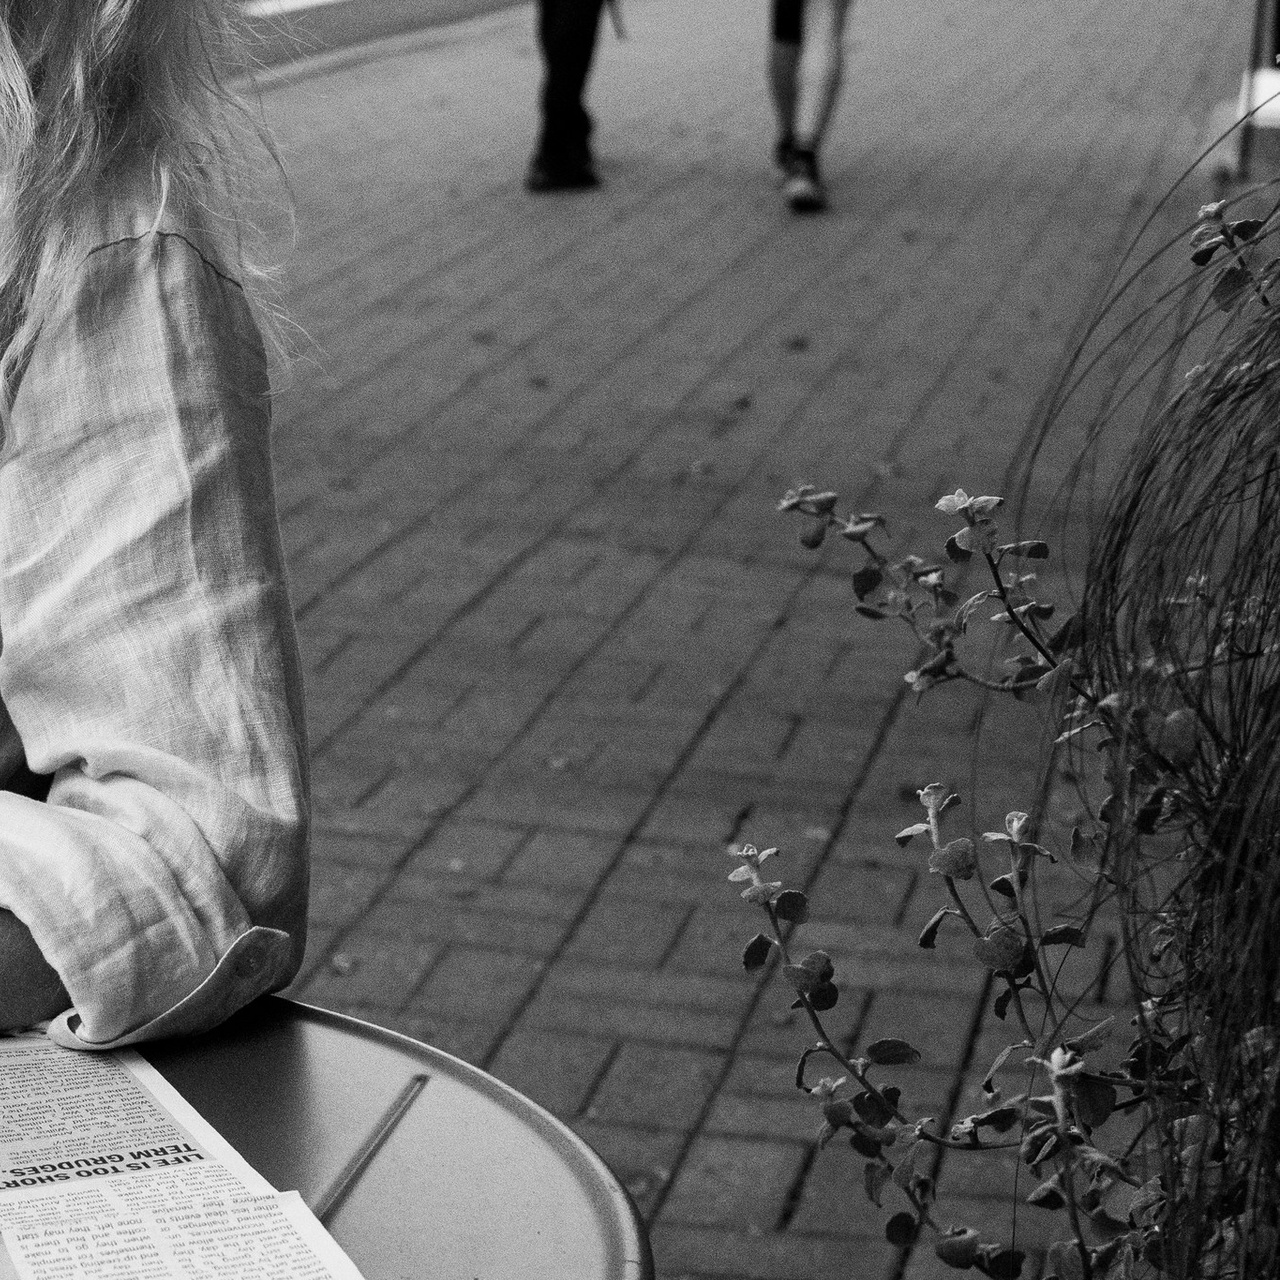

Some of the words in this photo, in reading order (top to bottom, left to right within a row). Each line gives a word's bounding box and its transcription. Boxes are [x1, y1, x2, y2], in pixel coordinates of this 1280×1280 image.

[127, 1142, 197, 1160] TERM
[0, 1153, 125, 1177] GRUDGES.
[124, 1160, 151, 1171] IS
[152, 1152, 205, 1167] LIFE
[74, 1165, 124, 1178] TOO
